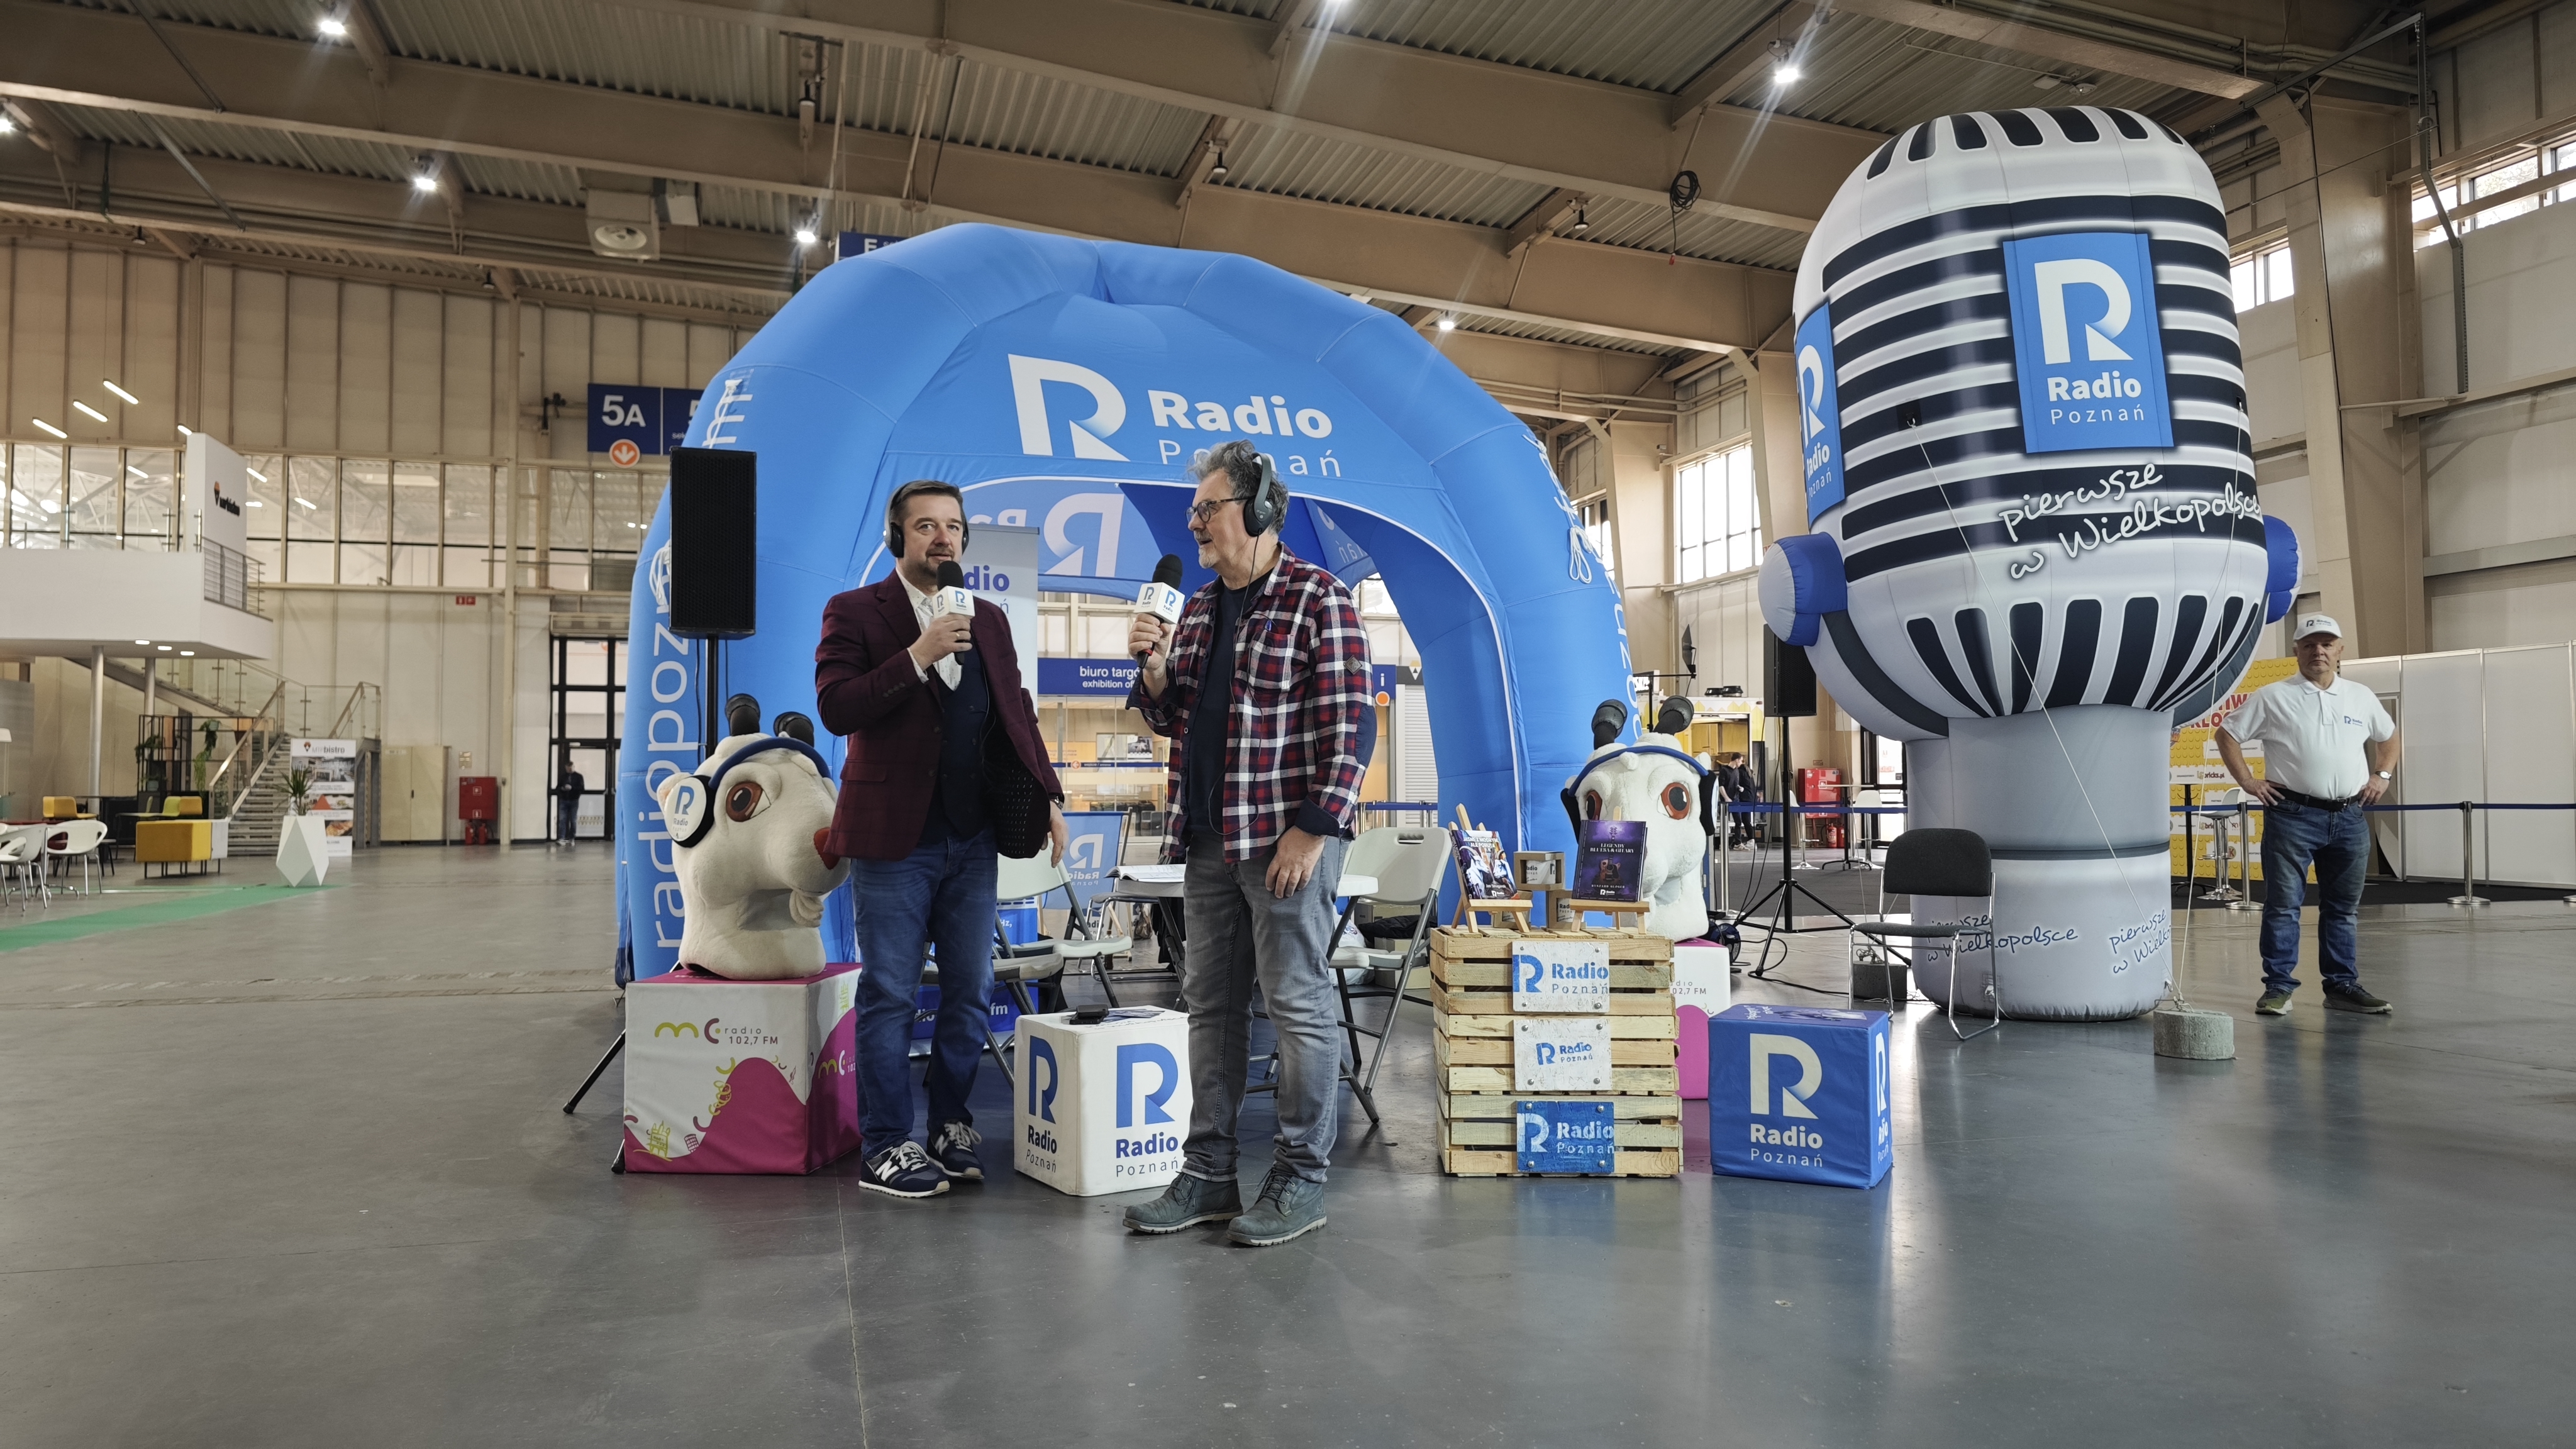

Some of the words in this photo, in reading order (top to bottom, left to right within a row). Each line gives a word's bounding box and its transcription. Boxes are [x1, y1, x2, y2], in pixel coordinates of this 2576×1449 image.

[2047, 370, 2142, 402] Radio
[601, 394, 647, 428] 5A
[1147, 389, 1333, 439] Radio
[2050, 404, 2145, 425] Poznań
[1998, 463, 2163, 543] pierwsze
[2058, 482, 2262, 558] Wielkopolsce
[963, 565, 1010, 592] dio
[1079, 666, 1109, 677] biuro
[1112, 666, 1140, 680] targó
[1082, 680, 1123, 689] exhibition
[673, 818, 689, 826] Radio
[2109, 909, 2167, 954] pierwsze
[1552, 962, 1609, 979] Radio
[1552, 982, 1609, 994] Poznań
[1672, 987, 1690, 996] 02,7
[729, 1036, 758, 1046] 102,7
[763, 1036, 779, 1045] FM
[1558, 1042, 1592, 1055] Radio
[1560, 1053, 1593, 1063] Poznań
[1027, 1124, 1058, 1155] Radio
[1557, 1121, 1614, 1140] Radio
[1750, 1123, 1823, 1149] Radio
[1116, 1131, 1179, 1158] Radio
[1557, 1141, 1614, 1155] Poznań
[1025, 1149, 1057, 1174] Poznań
[1116, 1156, 1179, 1178] Poznań
[1750, 1148, 1823, 1168] Poznań
